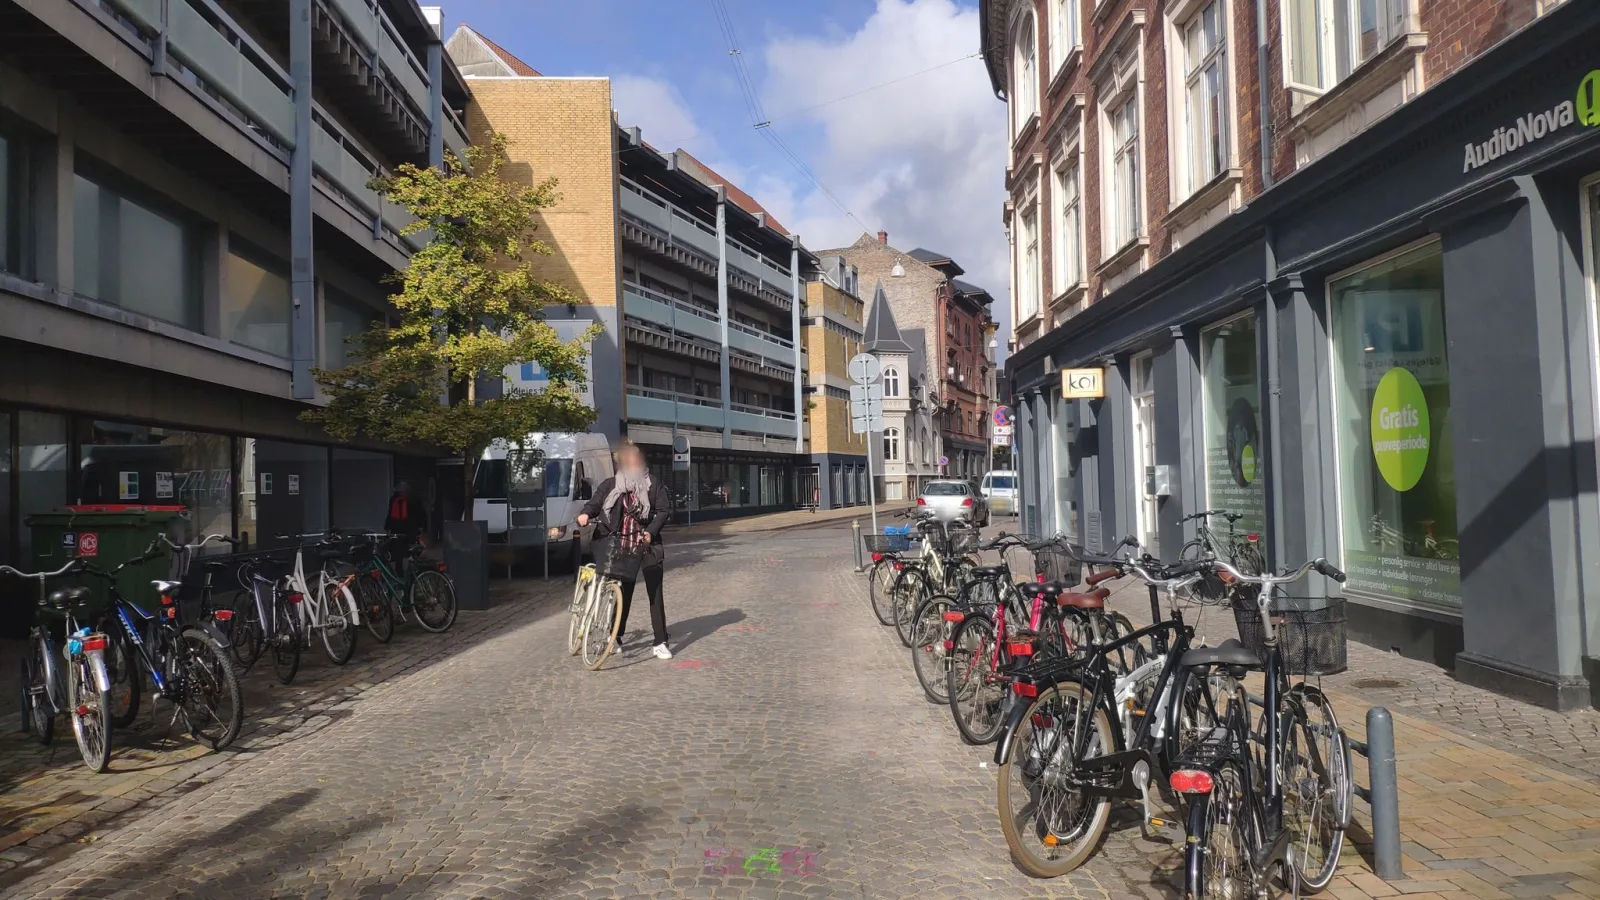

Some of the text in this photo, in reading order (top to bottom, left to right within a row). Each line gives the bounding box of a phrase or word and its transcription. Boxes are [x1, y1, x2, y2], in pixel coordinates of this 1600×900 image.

[1463, 99, 1574, 173] AudioNova
[1379, 404, 1419, 430] Gratis
[82, 537, 97, 550] HCS
[1381, 556, 1403, 569] personlig
[1403, 559, 1421, 569] service
